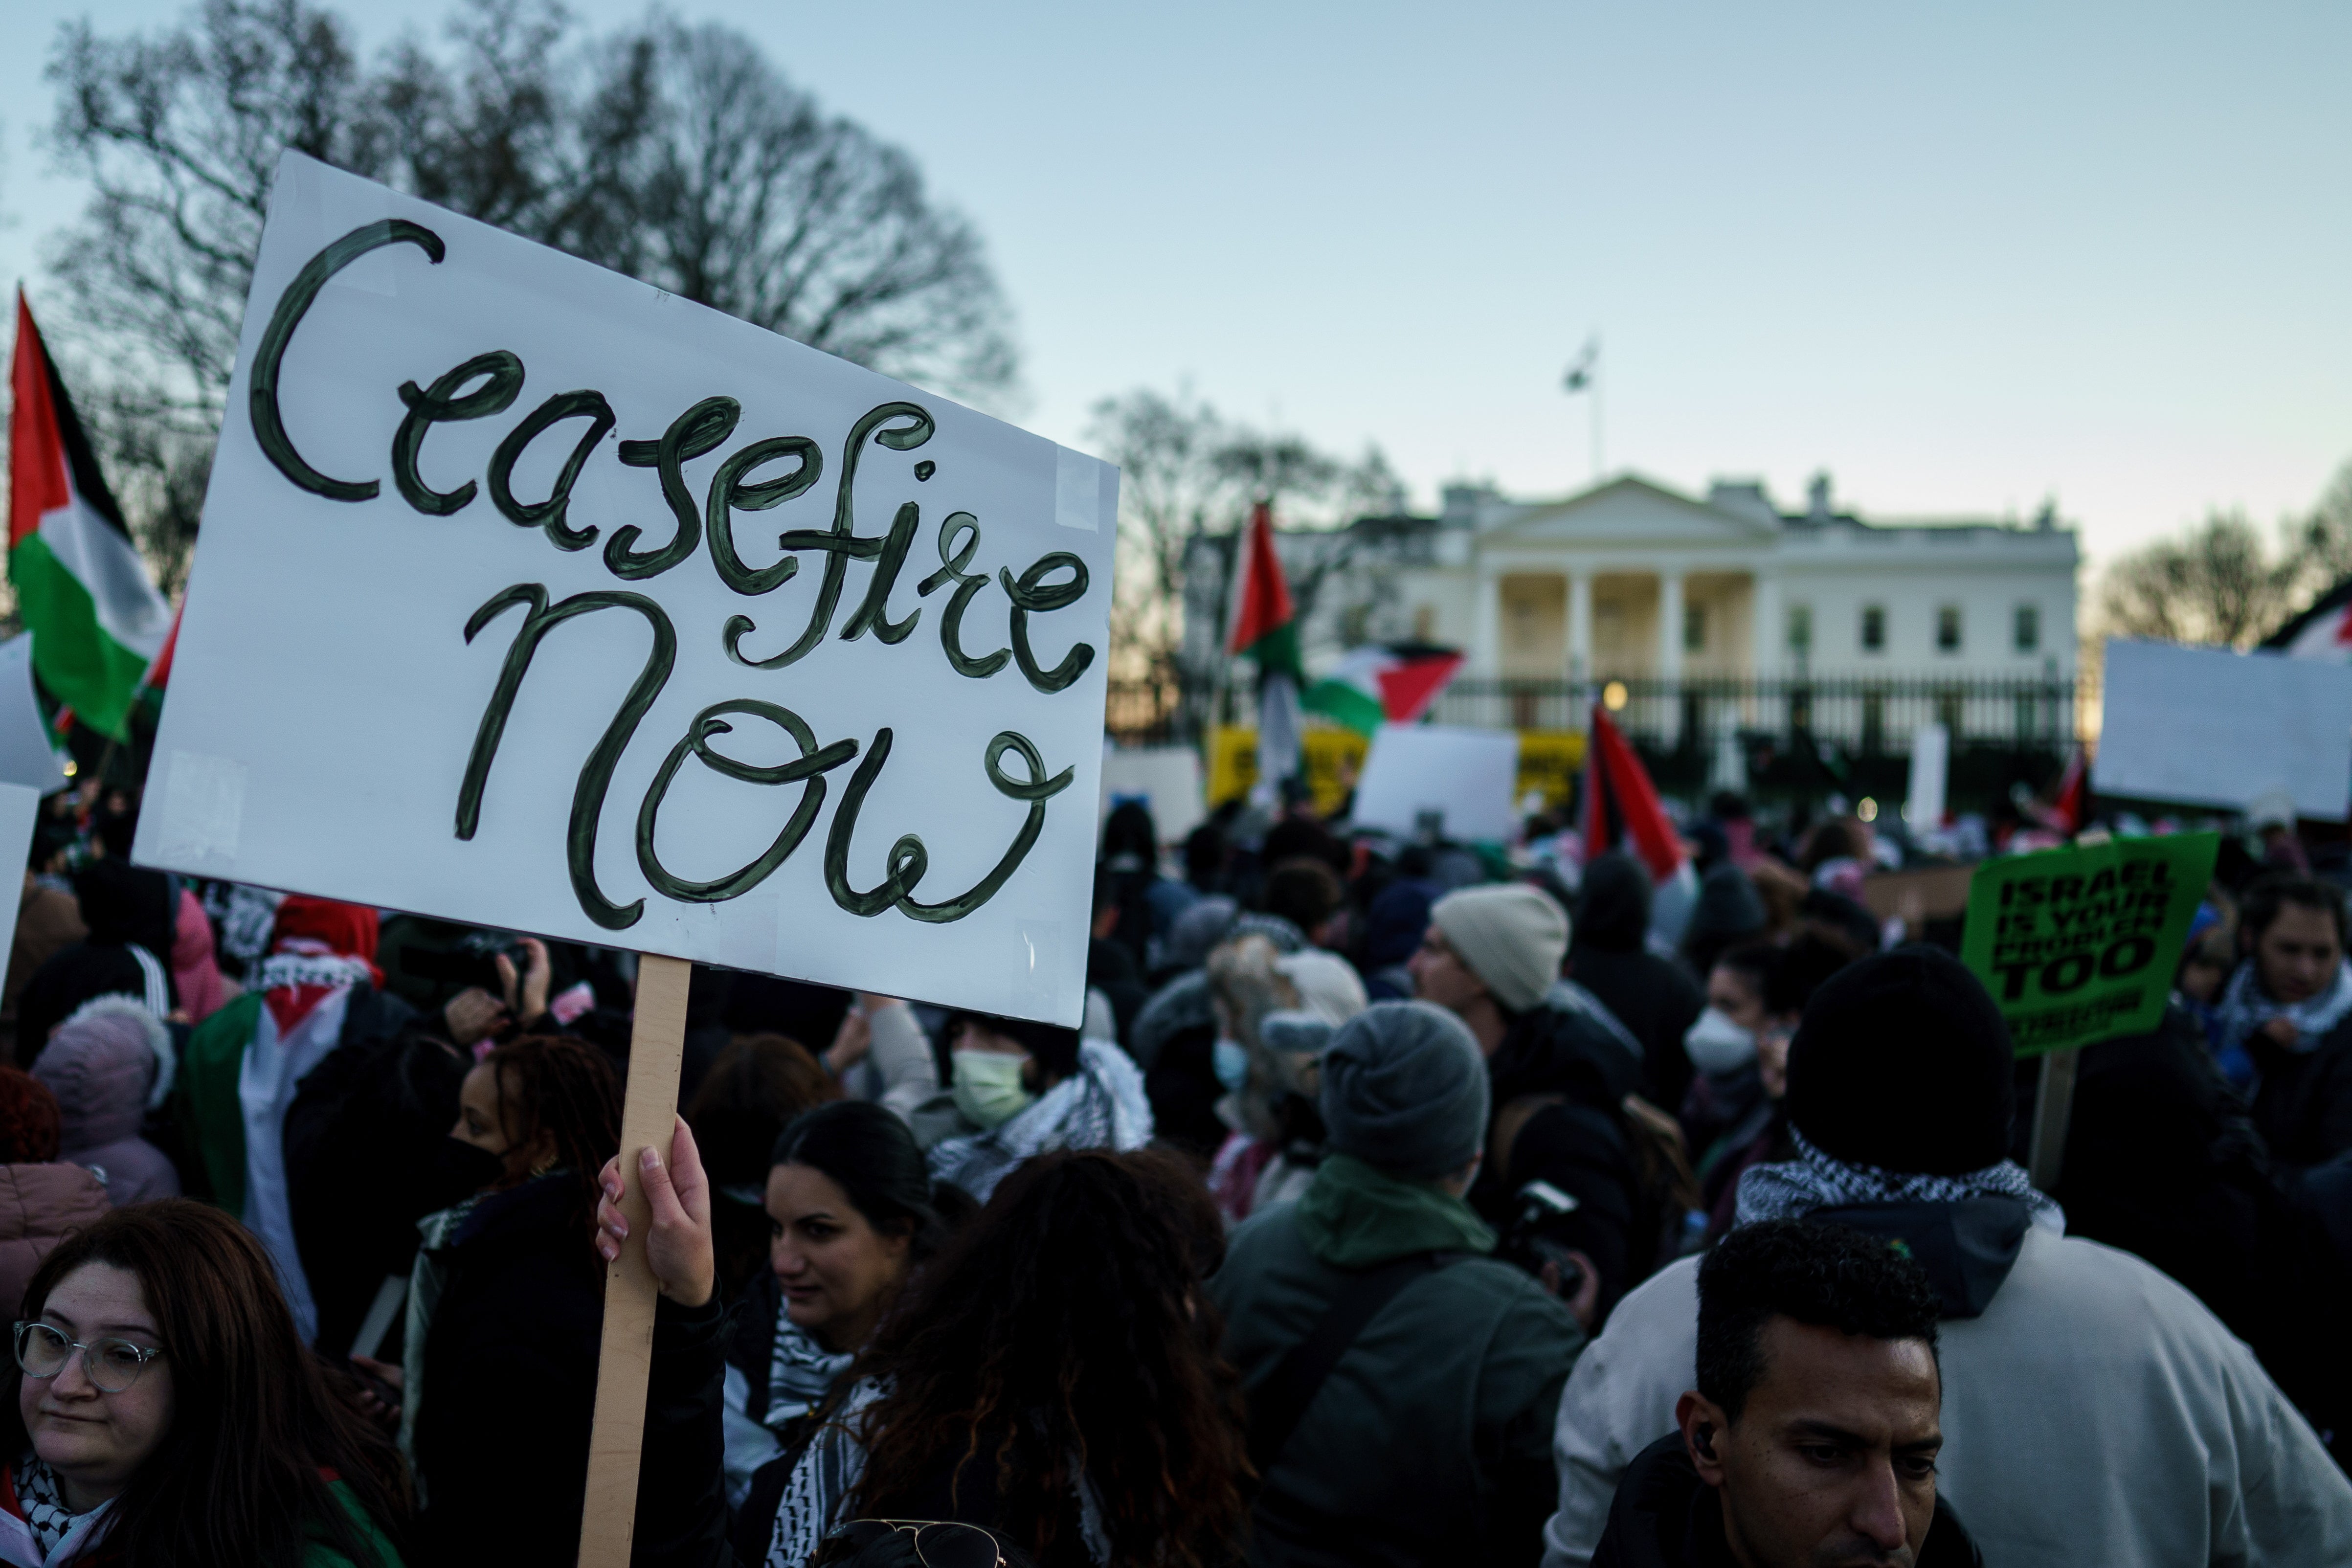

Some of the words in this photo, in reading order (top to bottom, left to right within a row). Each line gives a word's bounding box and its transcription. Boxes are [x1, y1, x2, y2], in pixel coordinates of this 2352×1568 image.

[248, 219, 1096, 694] Ceasefire
[2001, 858, 2175, 905] ISRAEL
[1998, 913, 2034, 935] IS
[2053, 893, 2170, 928] YOUR
[1993, 937, 2155, 998] TOO
